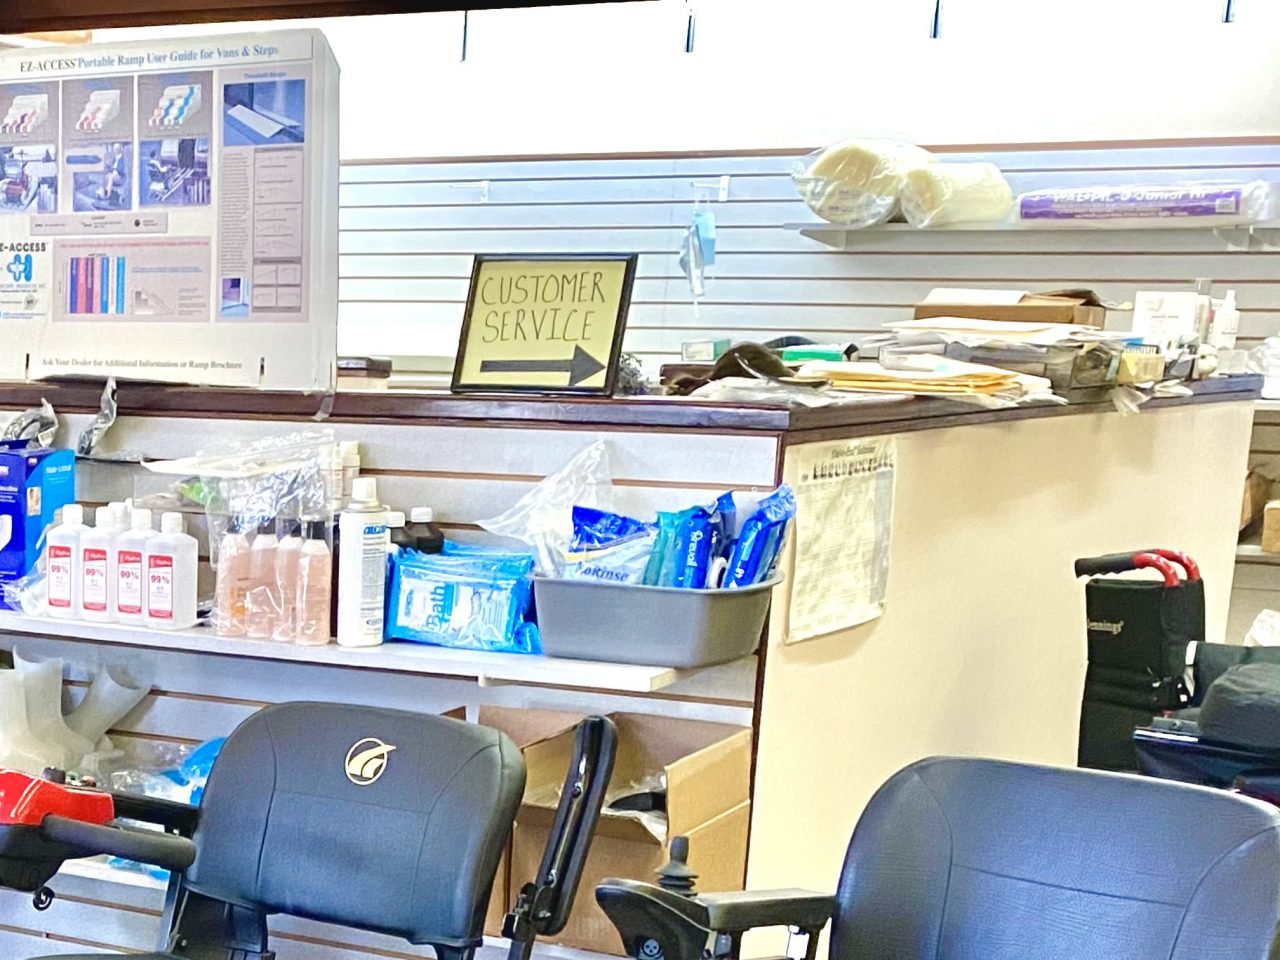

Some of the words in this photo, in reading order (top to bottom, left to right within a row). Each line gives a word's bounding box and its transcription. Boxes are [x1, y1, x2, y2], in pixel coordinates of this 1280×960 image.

[78, 55, 115, 69] Portable
[117, 53, 145, 67] Ramp
[147, 51, 167, 64] User
[170, 49, 198, 62] Guide
[200, 48, 214, 60] for
[217, 47, 239, 59] Vans
[241, 45, 250, 57] &
[253, 45, 279, 57] Steps
[481, 271, 605, 306] CUSTOMER
[482, 308, 595, 343] SERVICE
[93, 359, 103, 367] for
[105, 359, 138, 368] Additional
[139, 360, 178, 368] Information
[189, 361, 209, 370] Ramp
[210, 361, 243, 369] Brochure
[426, 583, 446, 630] Bath
